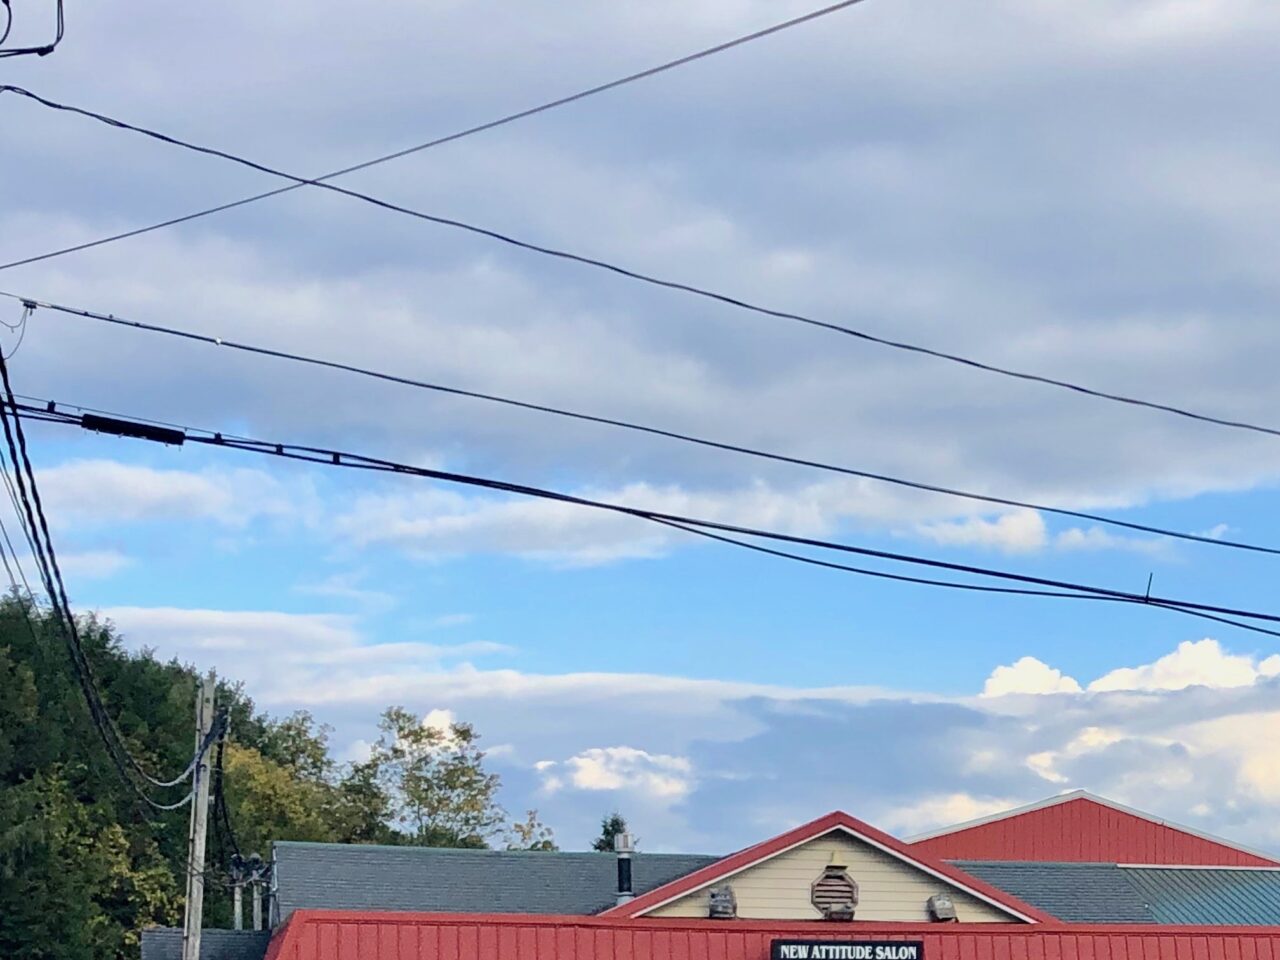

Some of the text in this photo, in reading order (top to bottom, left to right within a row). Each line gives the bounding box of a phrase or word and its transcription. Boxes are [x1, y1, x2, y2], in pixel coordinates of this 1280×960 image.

[780, 945, 917, 960] NEW ATTITUDE SALON
